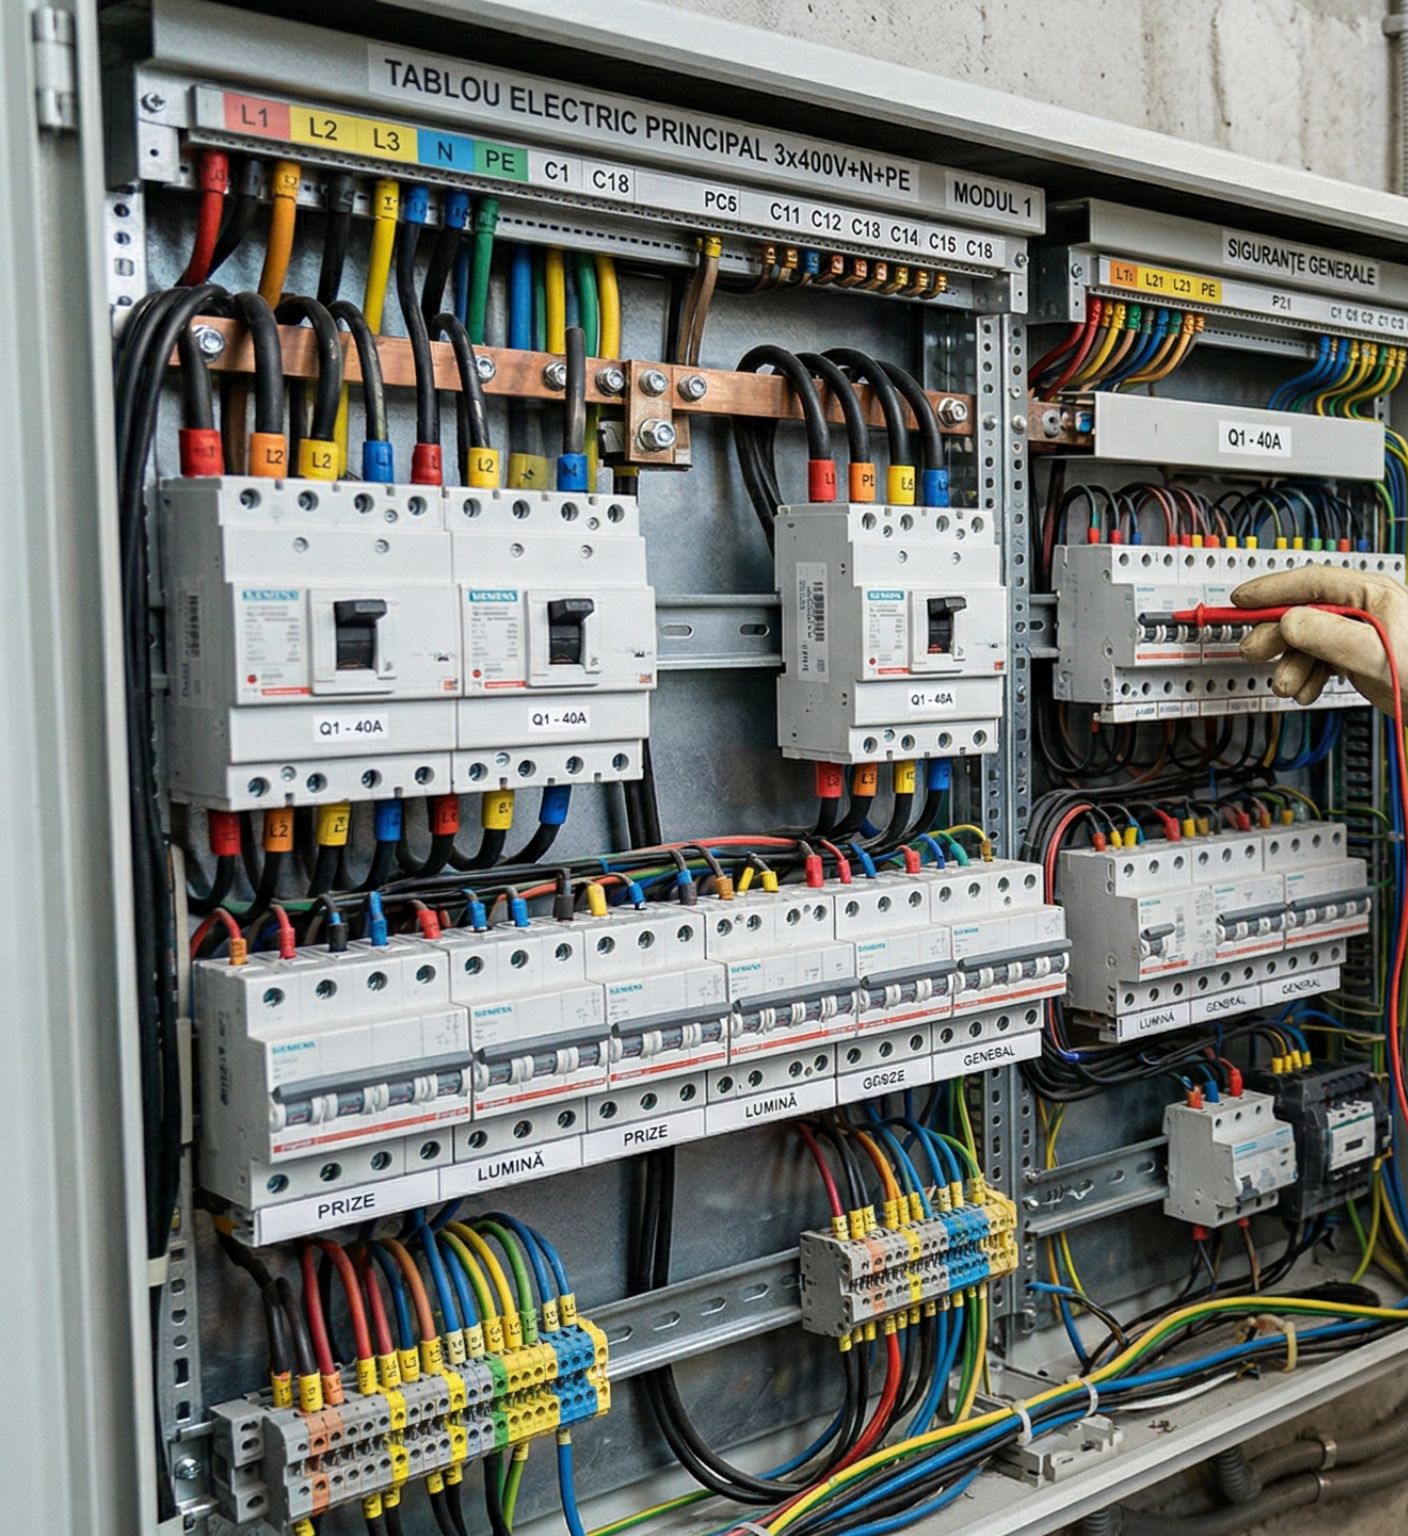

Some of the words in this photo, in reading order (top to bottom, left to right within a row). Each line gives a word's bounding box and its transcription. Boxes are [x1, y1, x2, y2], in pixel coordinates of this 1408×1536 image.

[384, 58, 500, 107] TABLOU
[510, 86, 637, 135] ELECTRIC
[645, 115, 768, 162] PRINCIPAL
[774, 143, 911, 192] 3x400V+N+PE
[241, 104, 269, 128] L1
[309, 116, 338, 141] L2
[373, 127, 401, 152] L3
[437, 141, 453, 162] N
[485, 149, 516, 173] PE
[544, 161, 569, 182] C1
[592, 170, 629, 193] C18
[770, 202, 800, 225] C11
[811, 210, 842, 232] C12
[890, 225, 918, 246] C14
[954, 181, 1018, 215] MODUL
[1024, 198, 1031, 218] 1
[1308, 255, 1376, 286] GENERALE
[1201, 282, 1216, 297] PE
[1228, 428, 1245, 447] Q1
[1256, 431, 1282, 450] 40A
[266, 449, 284, 464] L2
[312, 452, 331, 469] L2
[477, 457, 494, 473] L2
[911, 693, 925, 706] Q1
[319, 721, 340, 736] Q1
[354, 719, 383, 733] 40A
[532, 713, 550, 726] Q1
[562, 711, 587, 725] 40A
[623, 1124, 668, 1146] PRIZE
[478, 1151, 545, 1181] LUMINĂ
[318, 1193, 375, 1219] PRIZE
